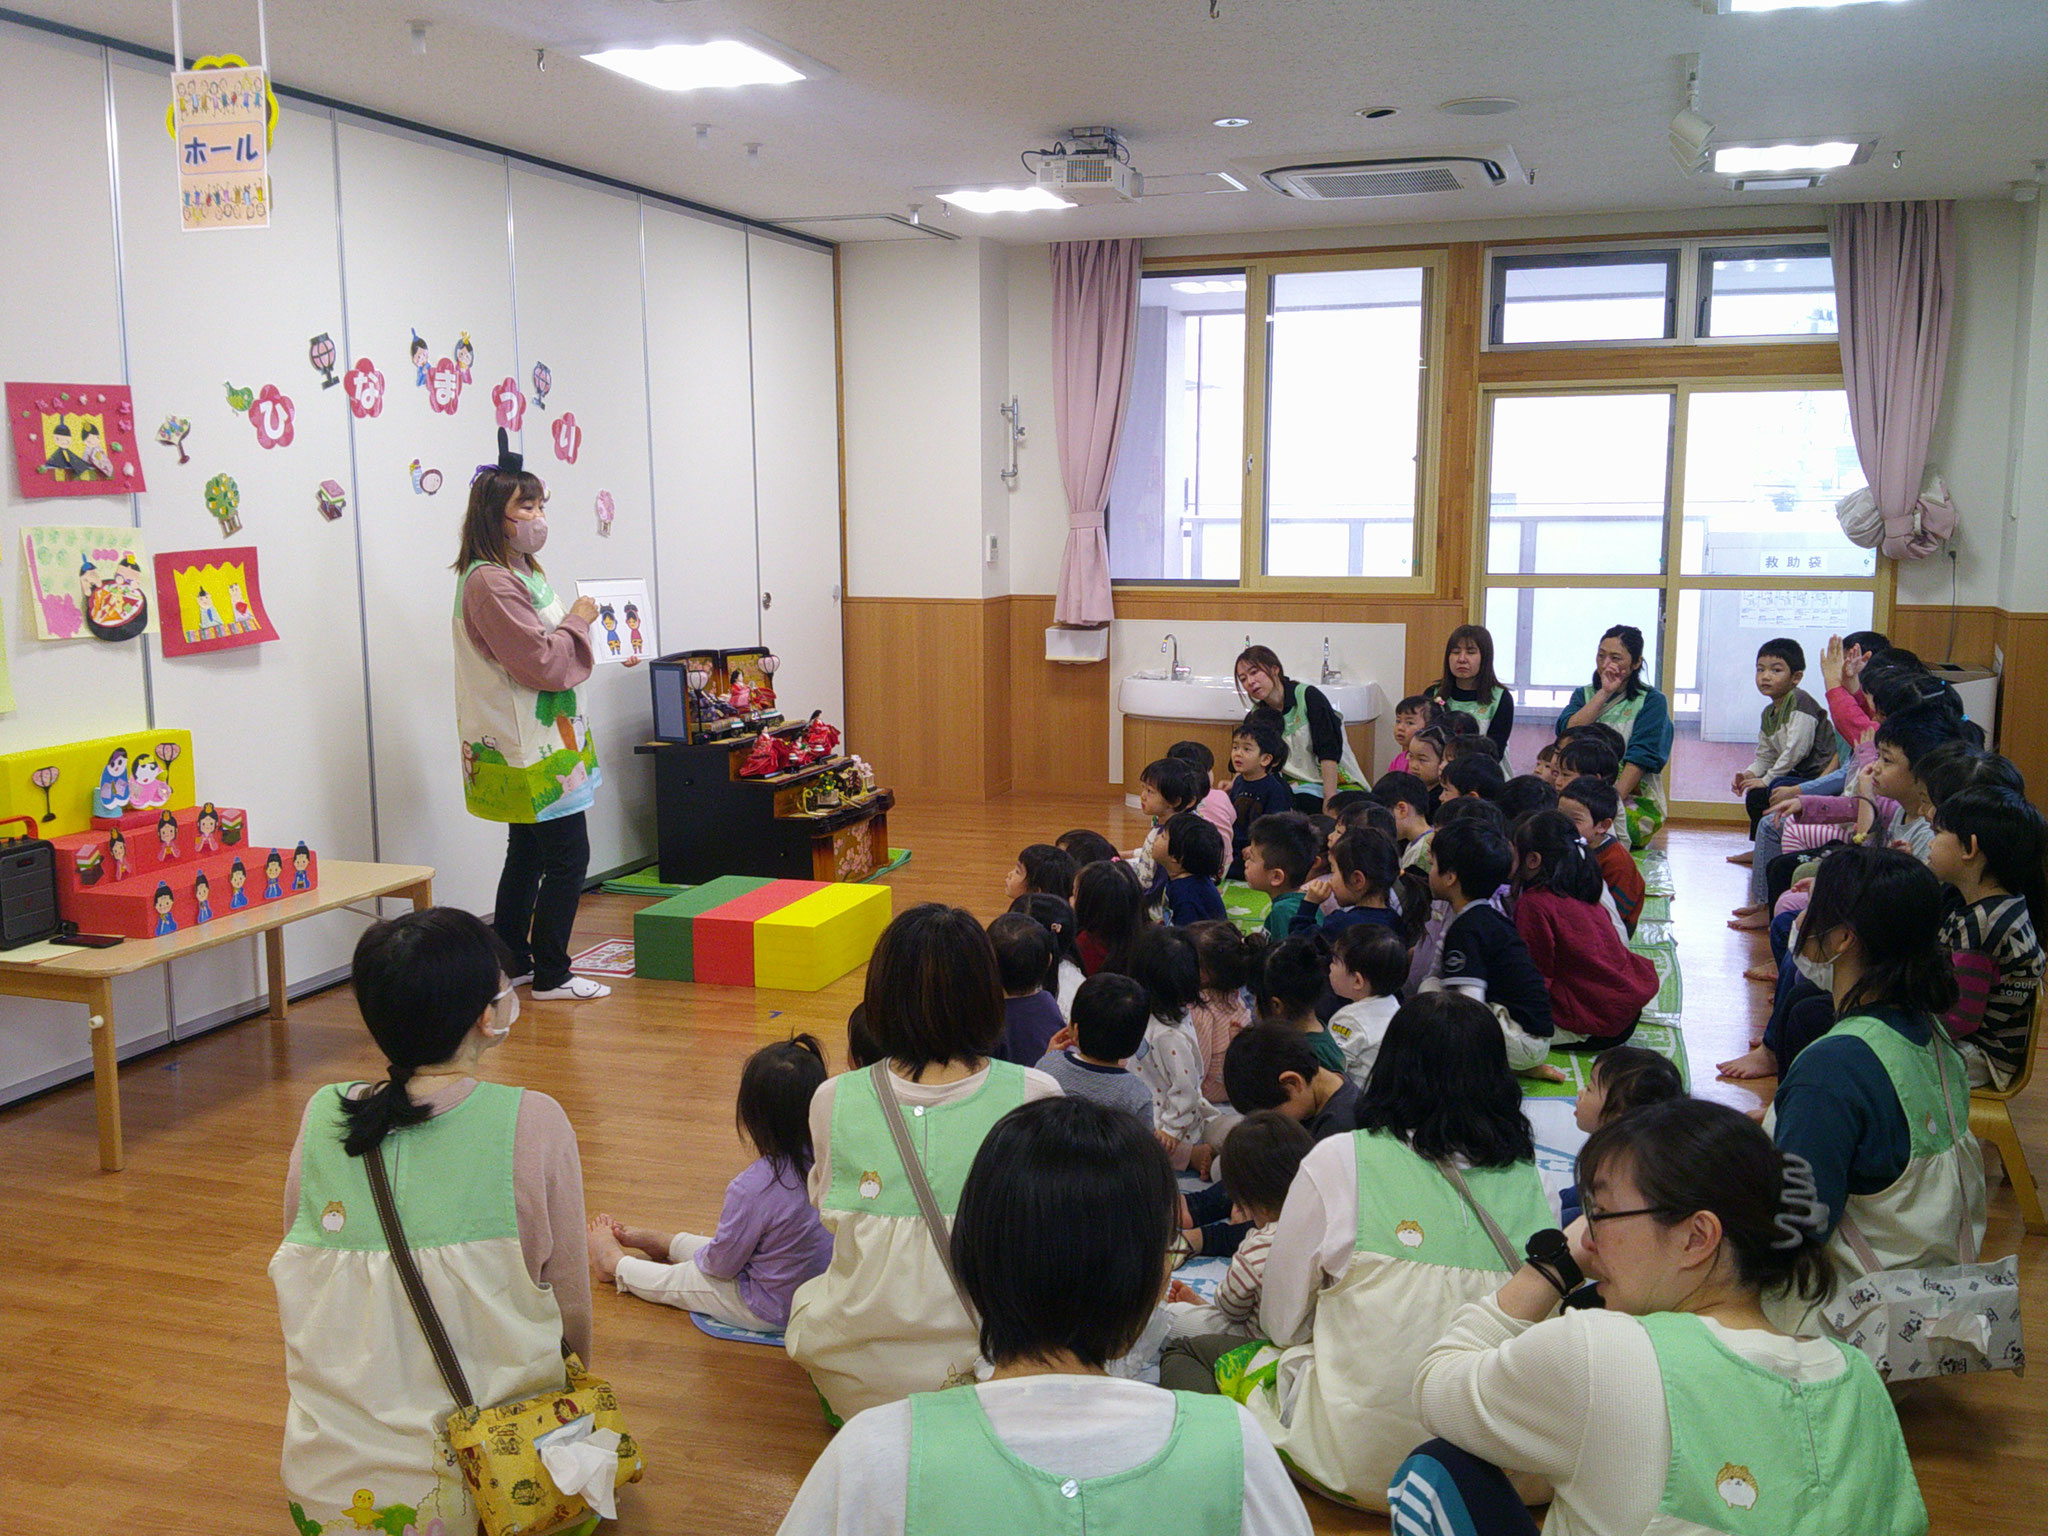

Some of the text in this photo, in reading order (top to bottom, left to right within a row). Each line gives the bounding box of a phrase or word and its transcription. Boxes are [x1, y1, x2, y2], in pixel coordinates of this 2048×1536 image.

[184, 133, 259, 165] ホール
[1765, 556, 1822, 569] 救助袋
